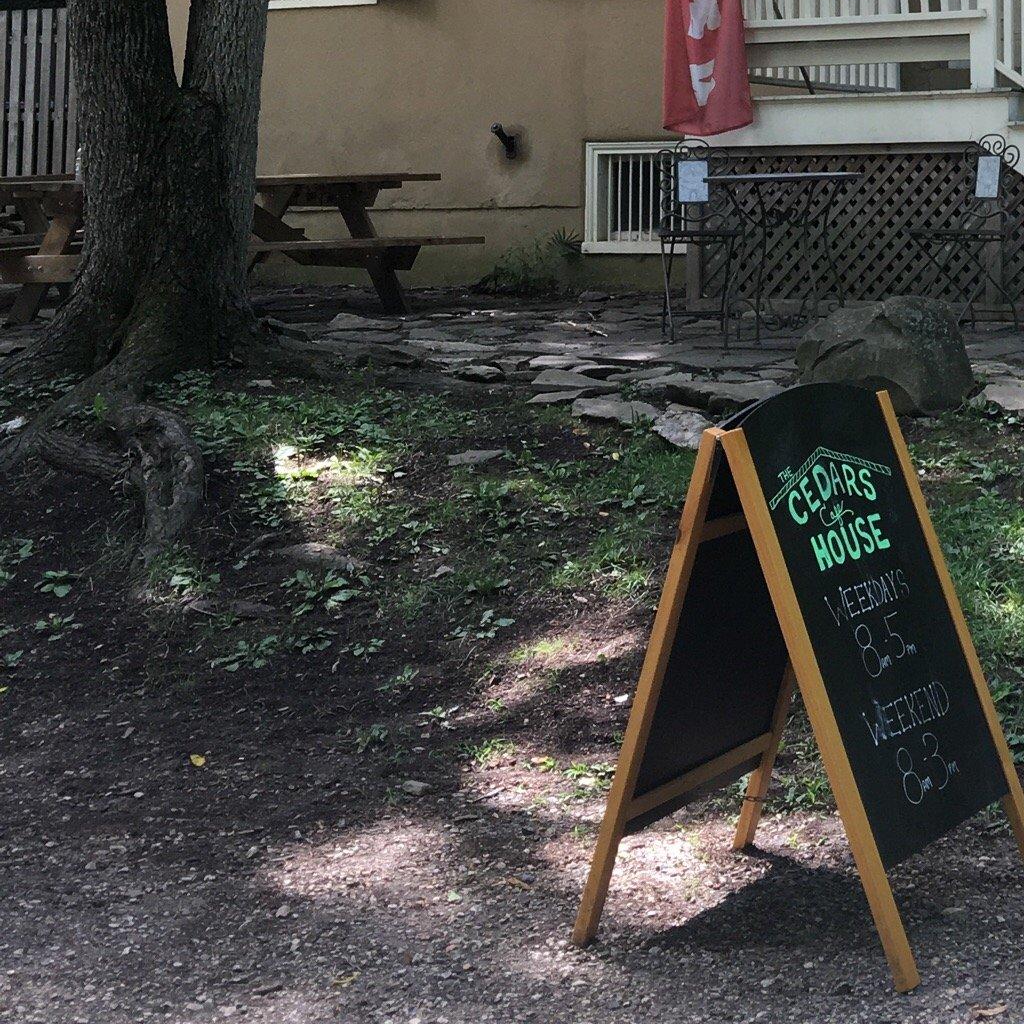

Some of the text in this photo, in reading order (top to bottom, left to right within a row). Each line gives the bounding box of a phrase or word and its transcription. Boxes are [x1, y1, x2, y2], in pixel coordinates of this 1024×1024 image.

[777, 466, 794, 483] THE
[788, 462, 877, 525] CEDARS
[810, 513, 891, 572] HOUSE
[824, 569, 910, 626] WEEKDAYS
[862, 681, 950, 746] WEEKEND
